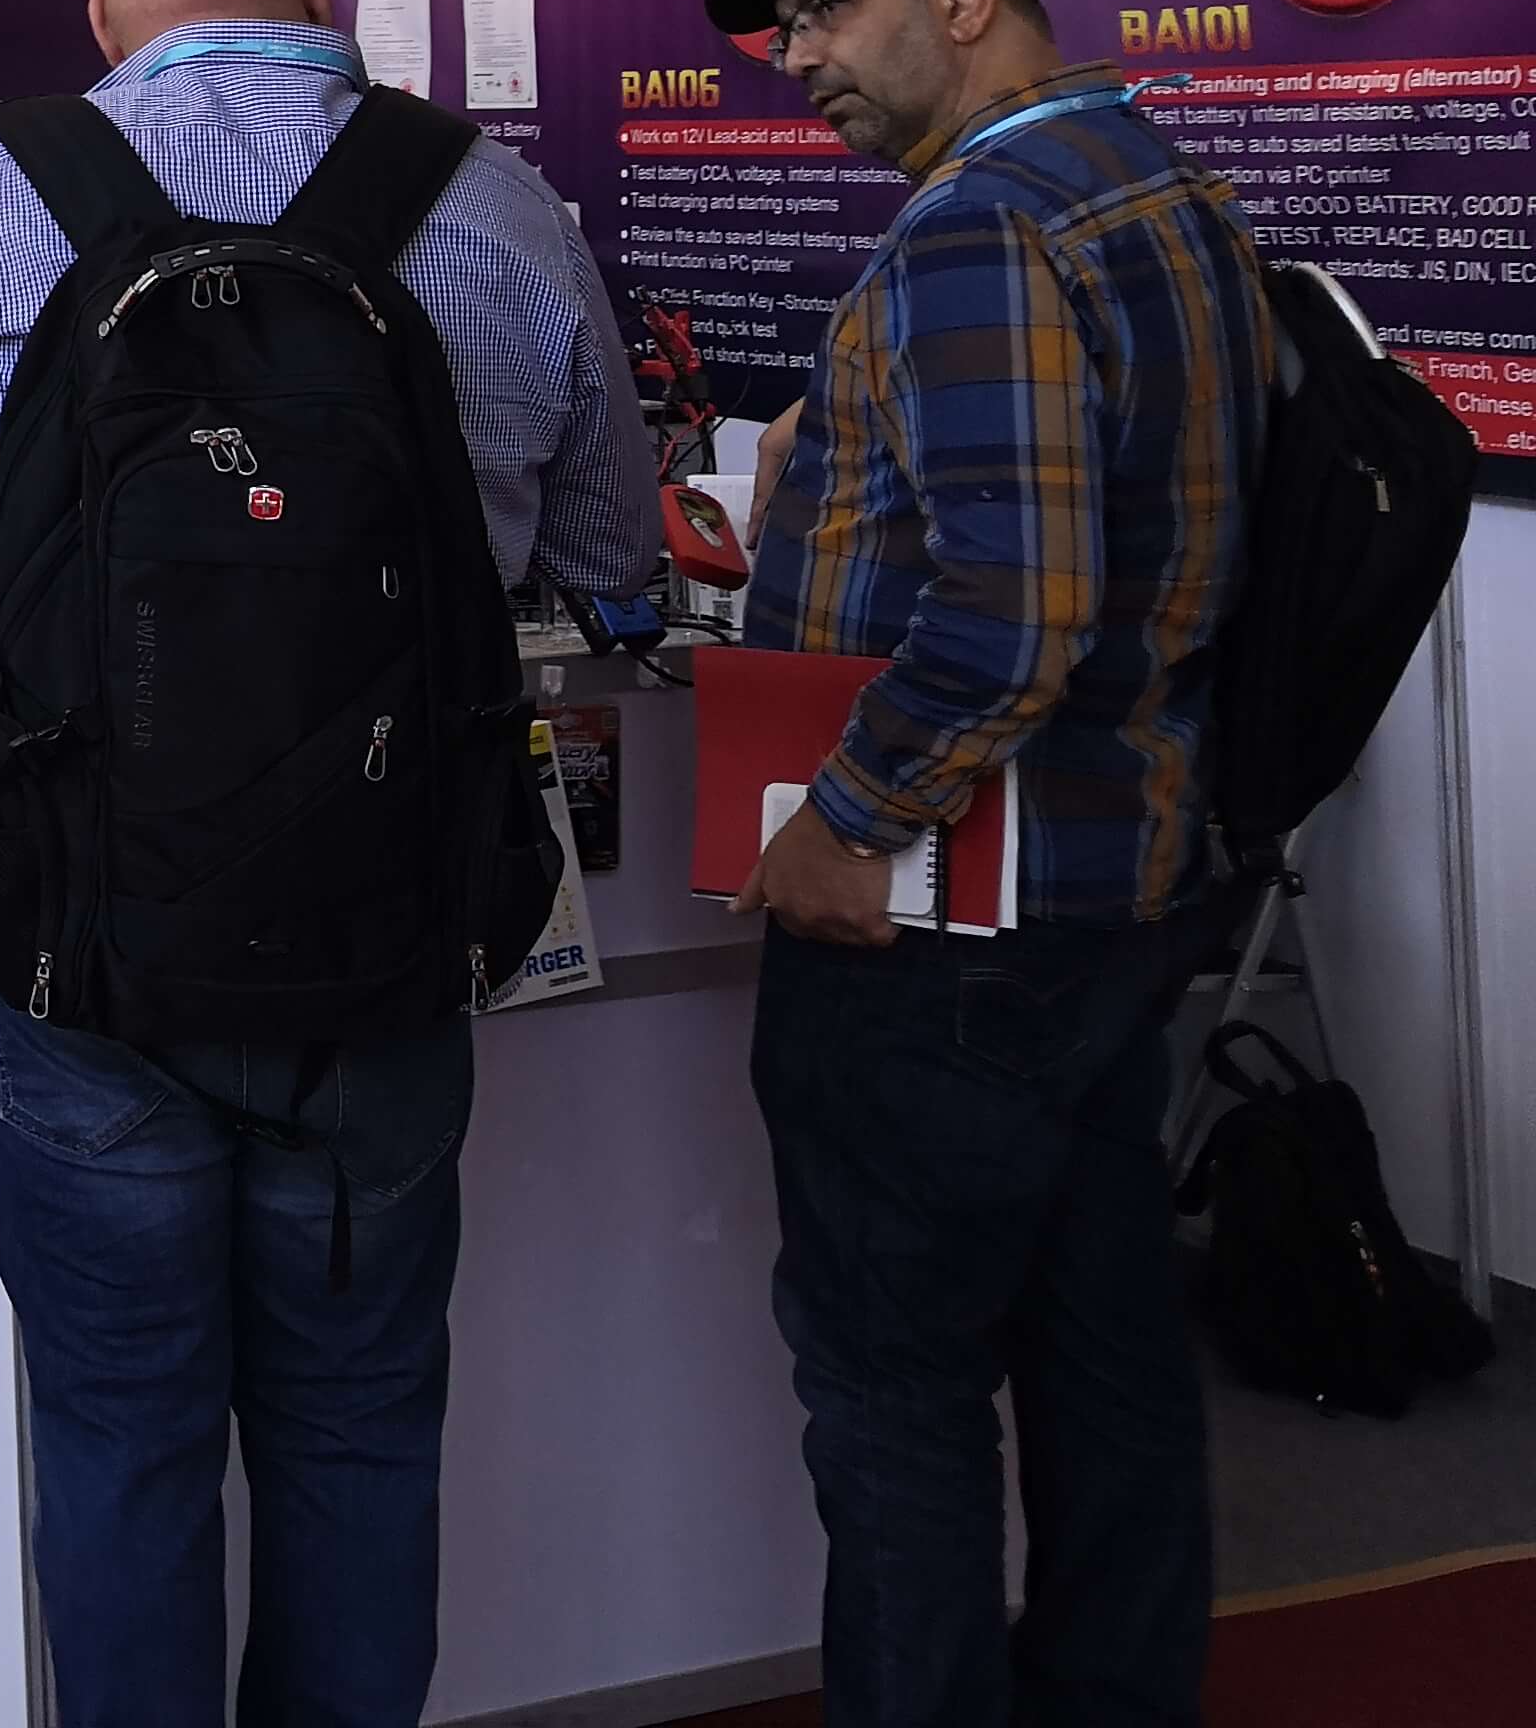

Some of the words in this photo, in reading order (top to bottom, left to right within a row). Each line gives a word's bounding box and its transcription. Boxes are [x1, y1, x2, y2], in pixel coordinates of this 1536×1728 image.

[1120, 3, 1254, 55] BA101
[621, 68, 721, 111] BA106
[630, 192, 656, 208] Test
[659, 196, 707, 213] charging
[711, 194, 734, 210] and
[737, 194, 783, 215] starting
[786, 196, 839, 215] systems
[1285, 196, 1350, 214] GOOD
[1355, 195, 1457, 217] BATTERY,
[1463, 196, 1522, 215] GOOD
[1333, 226, 1432, 249] REPLACE,
[1437, 228, 1476, 248] BAD
[1481, 228, 1532, 249] CELL
